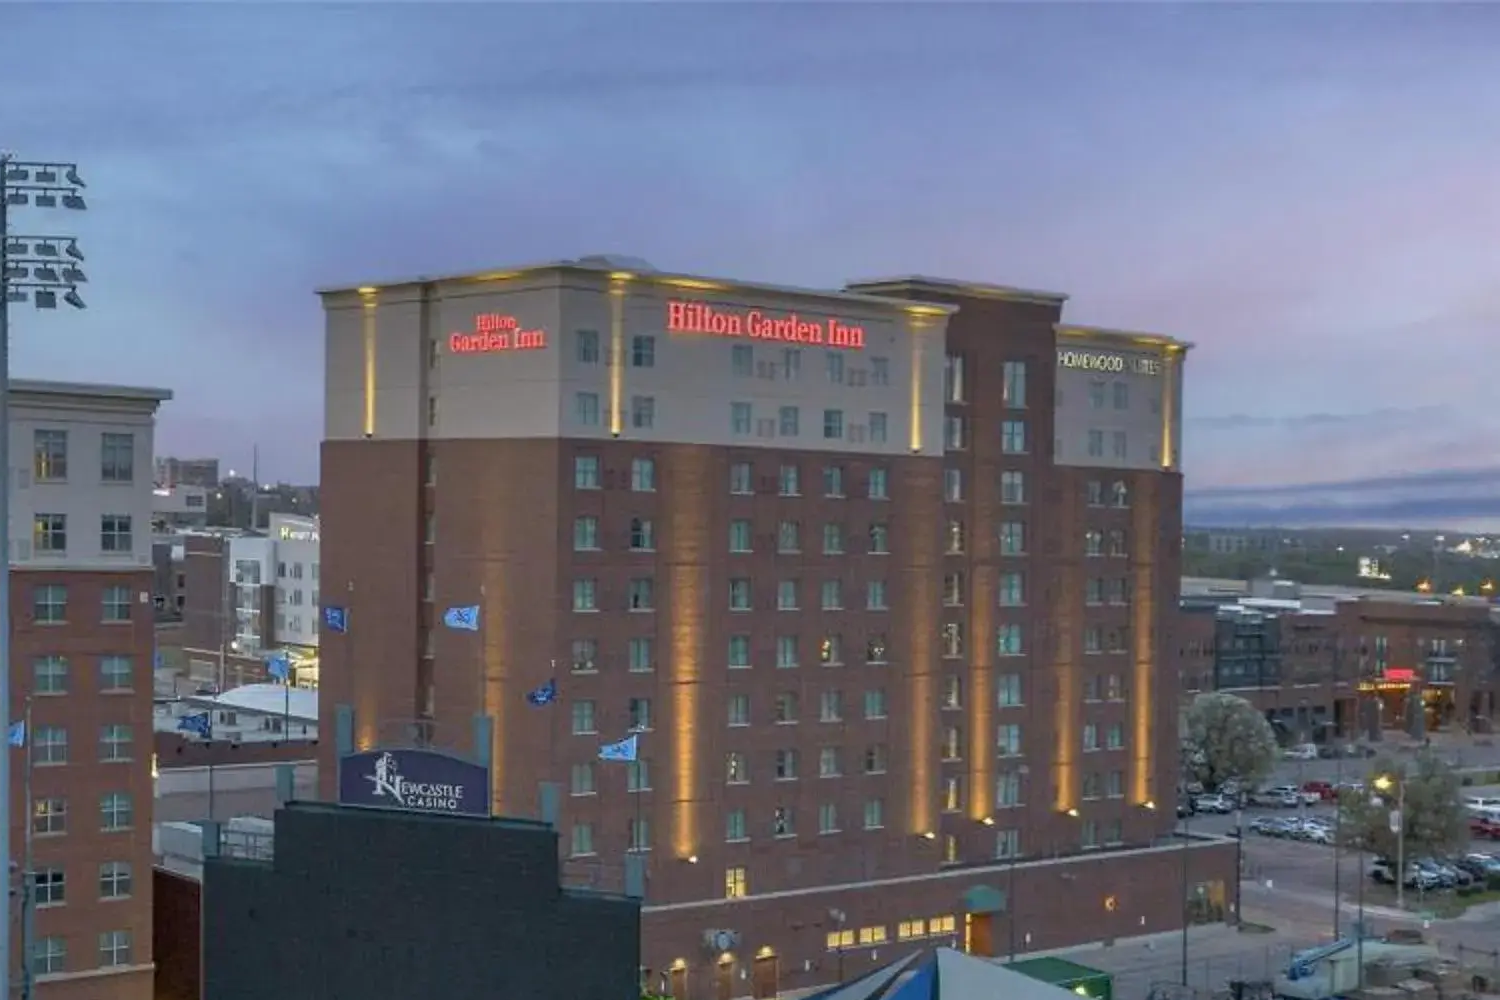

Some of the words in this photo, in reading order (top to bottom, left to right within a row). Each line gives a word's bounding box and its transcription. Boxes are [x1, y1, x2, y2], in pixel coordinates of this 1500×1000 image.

[476, 312, 518, 332] Hilton
[667, 300, 741, 336] Hilton
[746, 310, 822, 343] Garden
[826, 318, 865, 349] Inn
[451, 331, 510, 353] Garden
[514, 326, 545, 349] Inn
[1058, 351, 1124, 372] HOMEWOOD
[407, 794, 457, 810] CASINO
